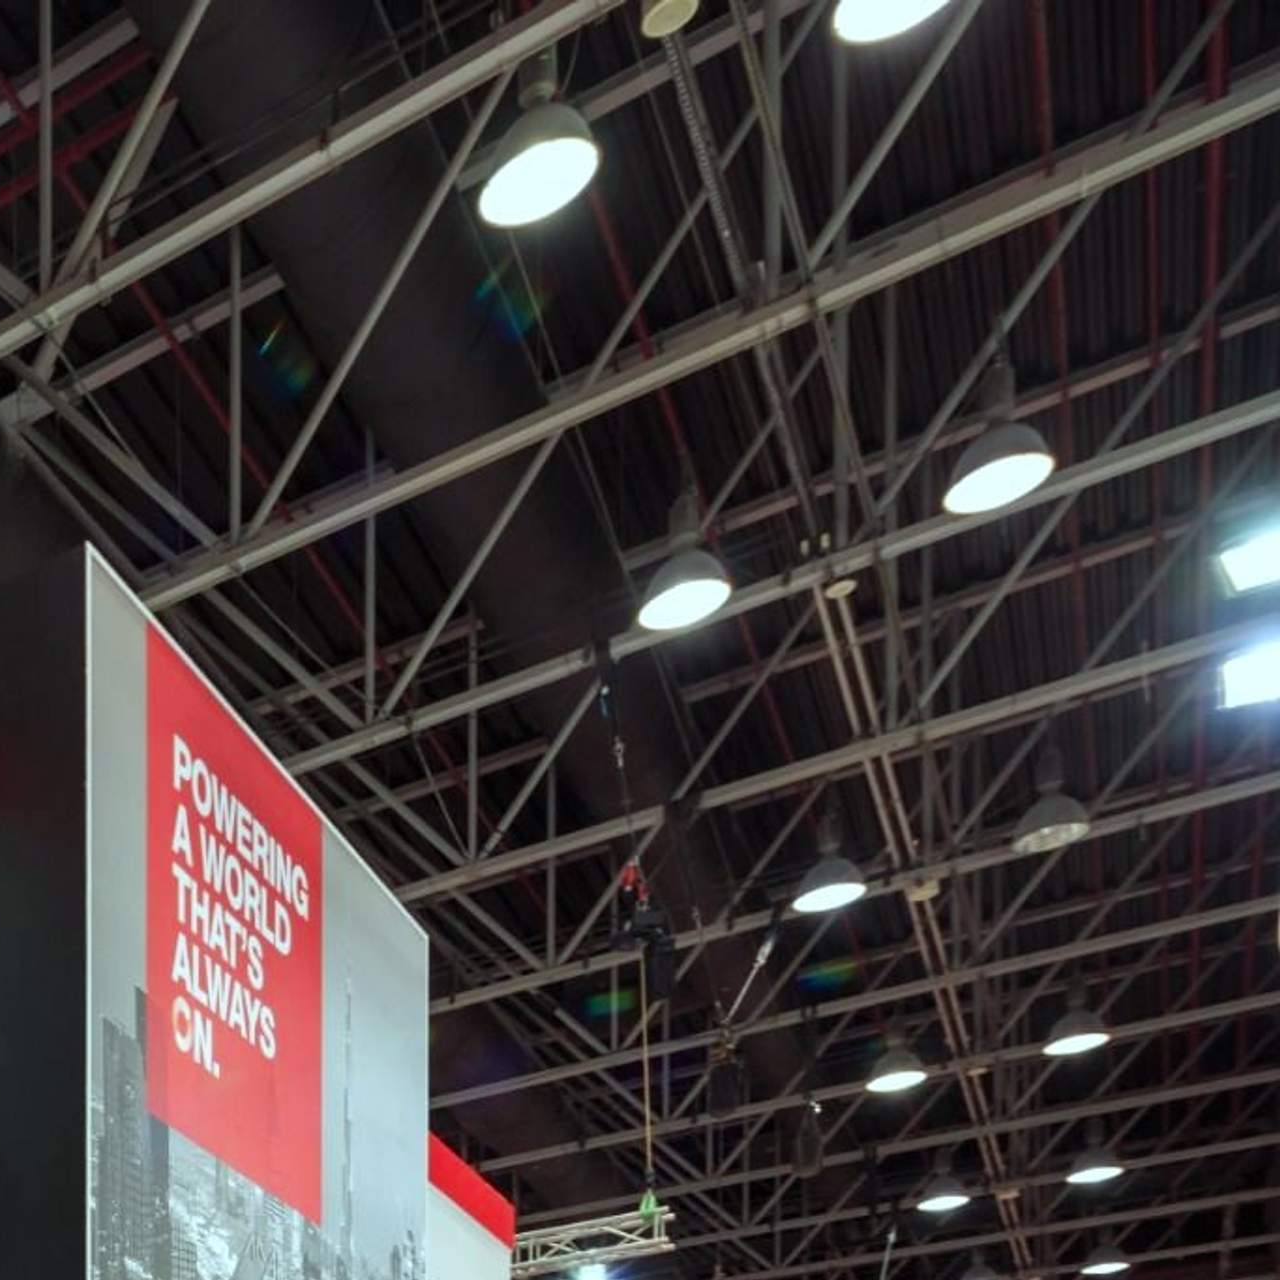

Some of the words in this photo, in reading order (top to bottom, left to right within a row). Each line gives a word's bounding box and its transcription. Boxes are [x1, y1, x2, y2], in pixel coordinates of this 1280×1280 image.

[172, 804, 193, 867] A
[200, 823, 291, 956] WORLD
[173, 734, 309, 919] POWERING
[172, 861, 263, 990] THAT'S
[172, 932, 276, 1059] ALWAYS
[172, 996, 220, 1078] ON.
